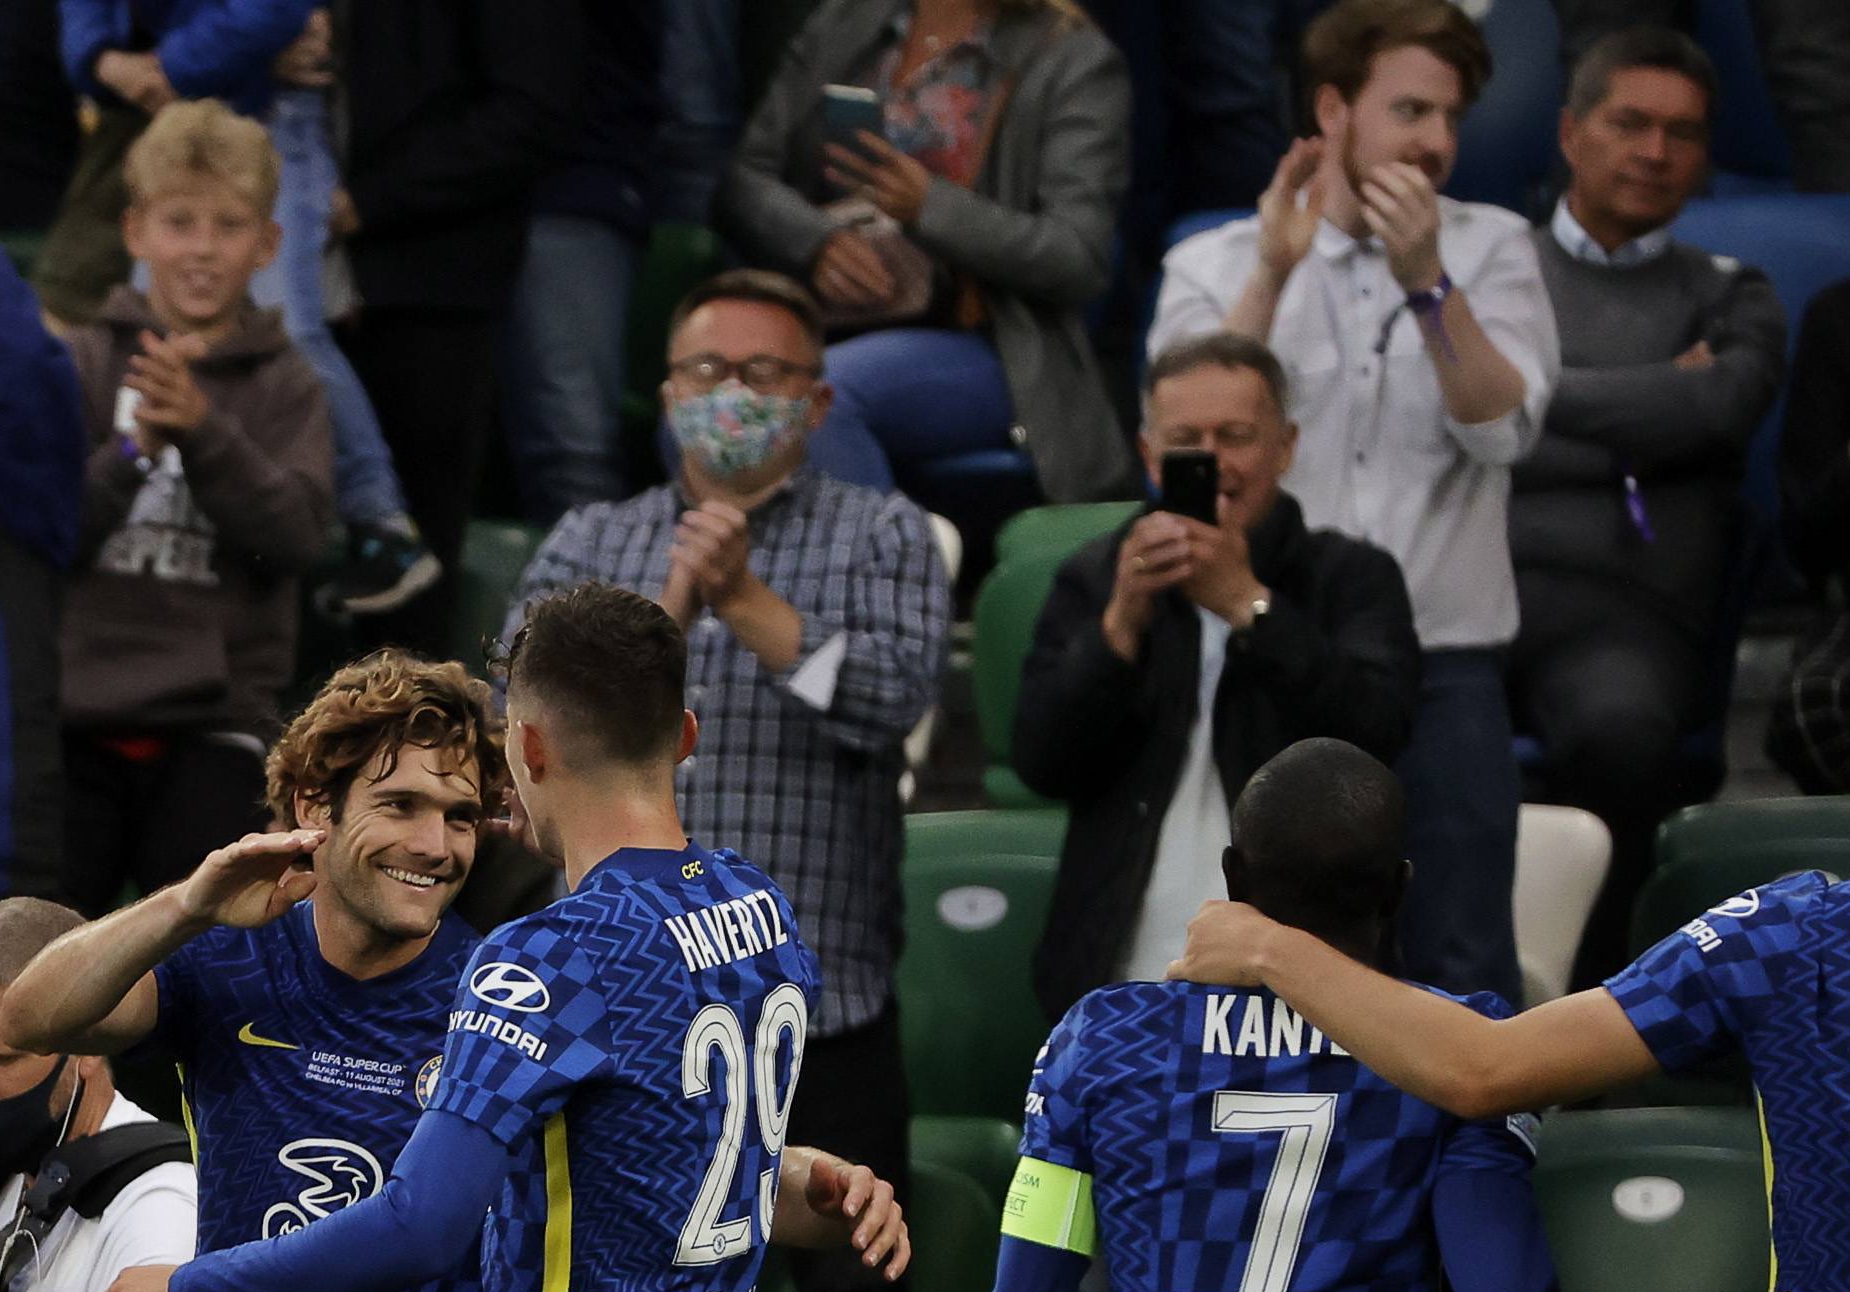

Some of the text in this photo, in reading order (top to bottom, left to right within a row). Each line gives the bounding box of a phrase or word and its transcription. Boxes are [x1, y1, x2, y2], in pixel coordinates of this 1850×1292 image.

[681, 860, 704, 880] CFC
[664, 889, 787, 973] HAVERTZ
[1202, 994, 1351, 1057] KAN
[308, 1063, 340, 1076] BELFAST
[346, 1070, 353, 1079] 11
[354, 1073, 386, 1084] AUGUST
[312, 1051, 341, 1065] UEFA
[671, 982, 807, 1267] 29
